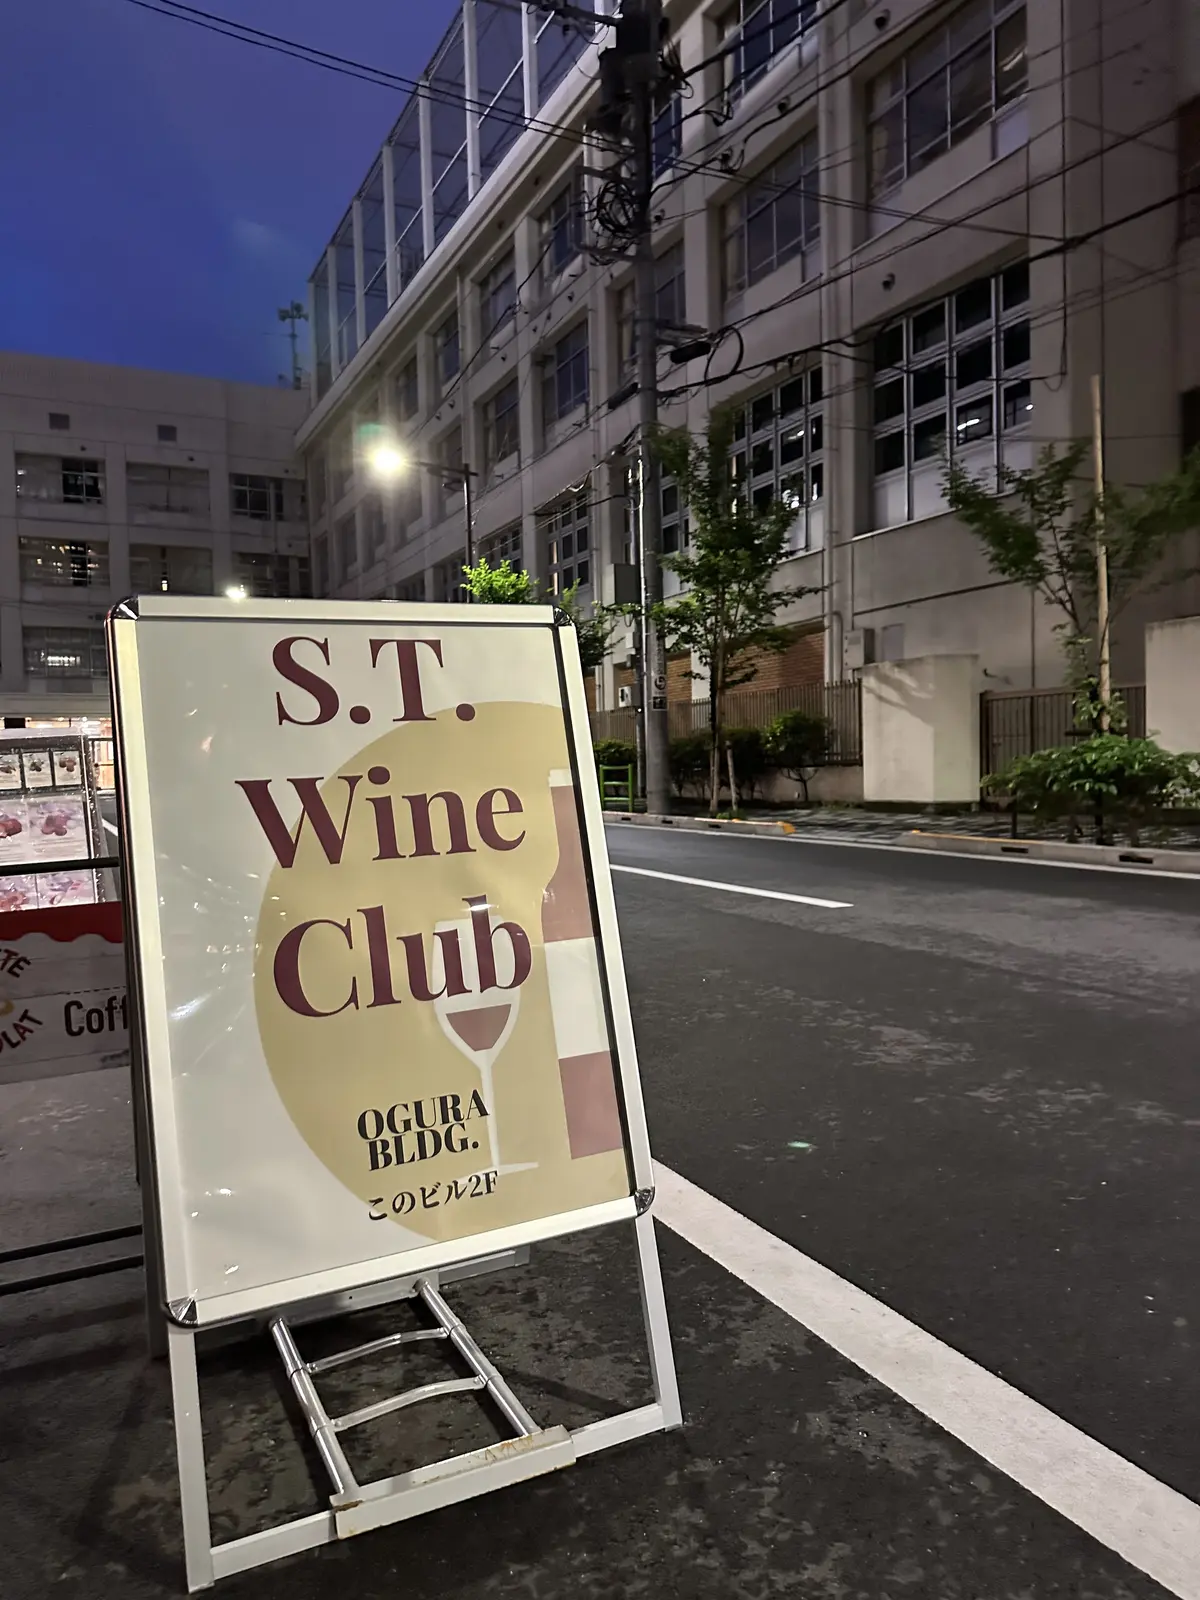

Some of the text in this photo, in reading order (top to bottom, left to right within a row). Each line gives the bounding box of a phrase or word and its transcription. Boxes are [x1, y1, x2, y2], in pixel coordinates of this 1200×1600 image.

[273, 636, 476, 725] S.T.
[235, 766, 526, 868] Wine
[0, 948, 31, 978] TE
[273, 895, 532, 1018] Club
[357, 1089, 490, 1141] OGURA
[366, 1122, 479, 1171] BLDG.
[368, 1170, 498, 1221] このビル2F
